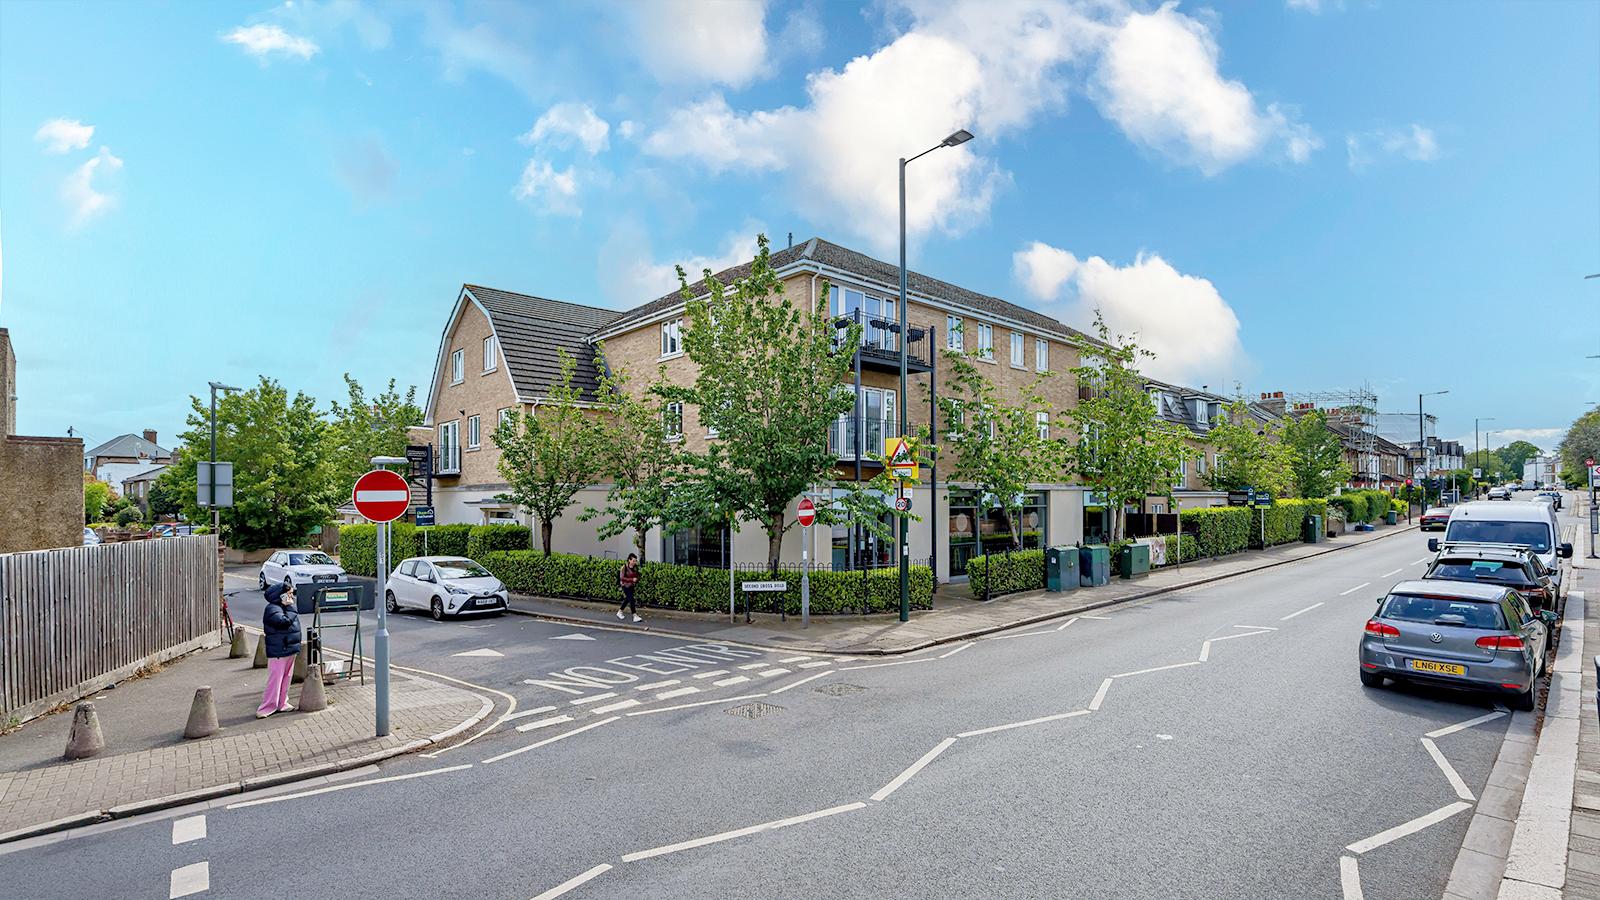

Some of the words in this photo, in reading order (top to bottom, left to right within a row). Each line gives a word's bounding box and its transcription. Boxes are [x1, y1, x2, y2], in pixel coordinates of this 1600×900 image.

[523, 666, 640, 695] NO
[604, 643, 762, 675] ENTR
[1415, 661, 1437, 670] LN61
[1439, 663, 1458, 673] XSE
